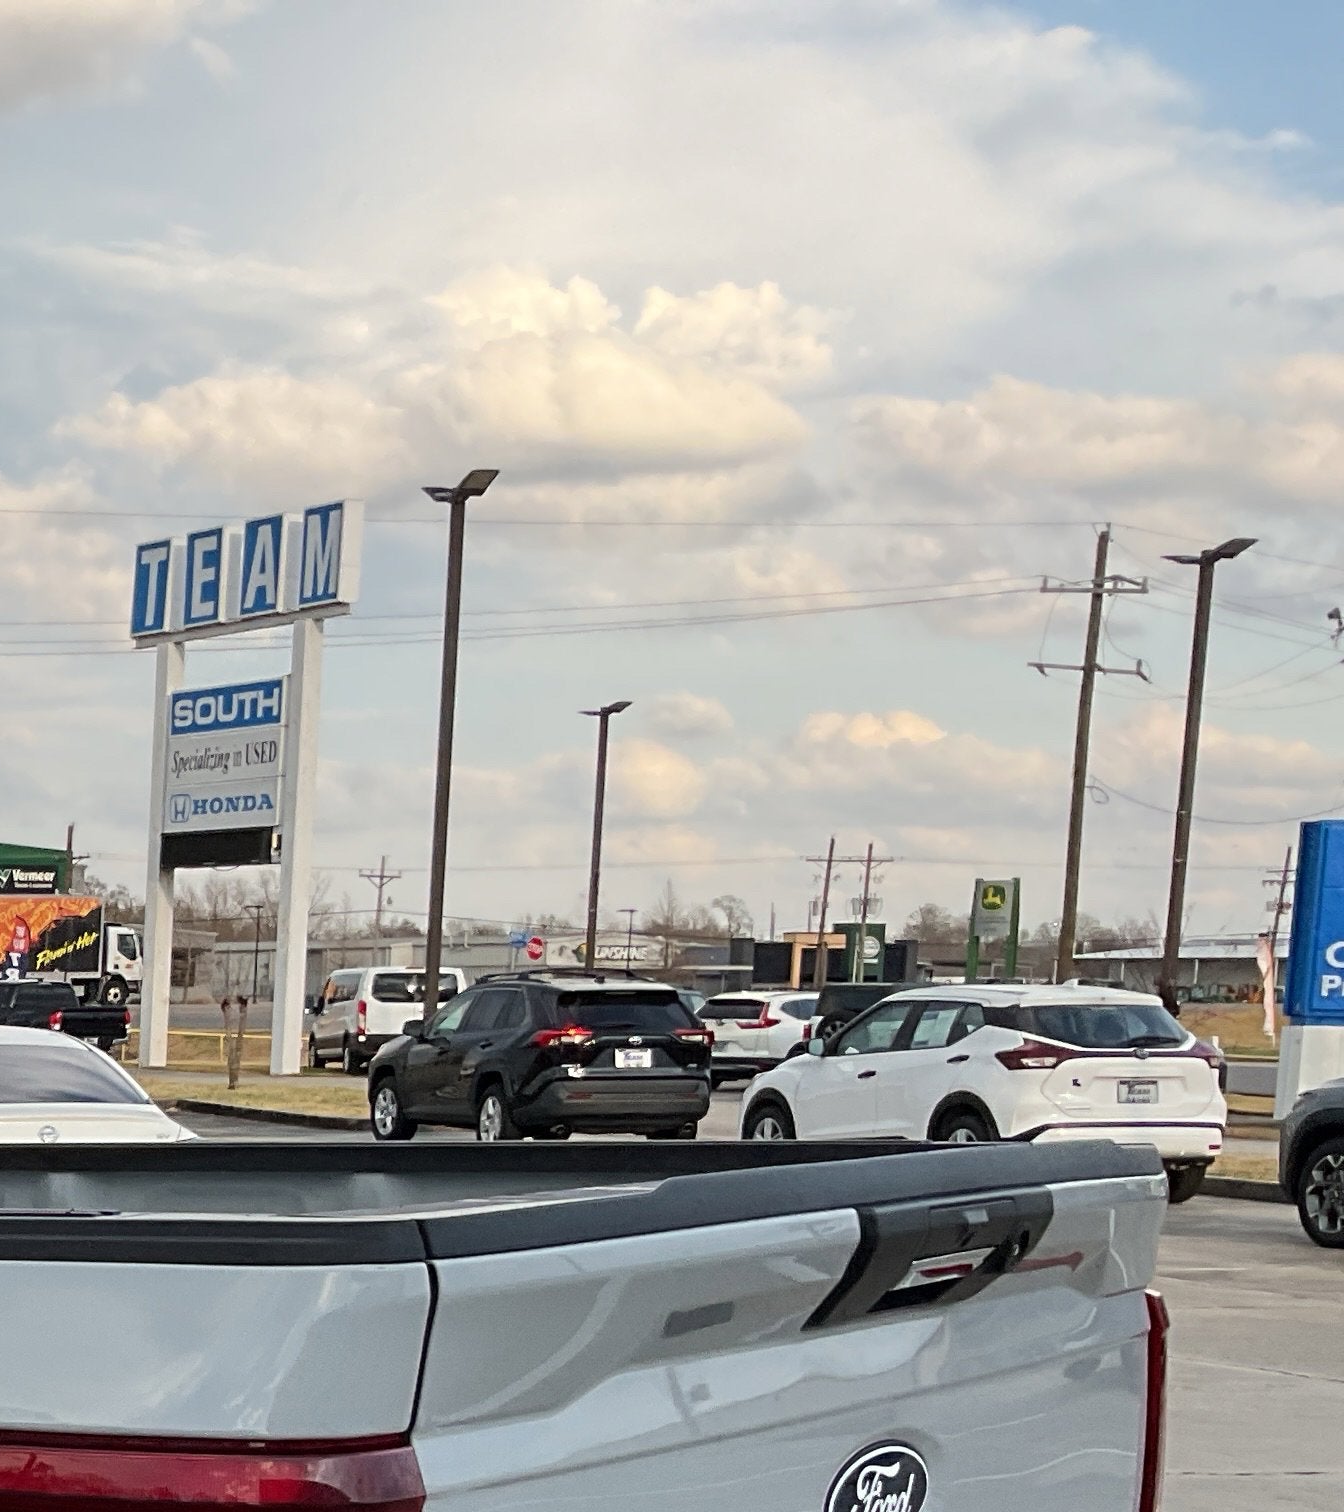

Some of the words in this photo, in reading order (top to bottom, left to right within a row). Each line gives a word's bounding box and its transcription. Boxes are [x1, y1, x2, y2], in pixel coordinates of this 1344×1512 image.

[140, 509, 341, 627] TEAM
[174, 687, 280, 727] SOUTH
[171, 746, 231, 778] Specializing
[246, 740, 277, 766] USED
[192, 793, 273, 815] HONDA
[12, 868, 56, 881] Vermeer
